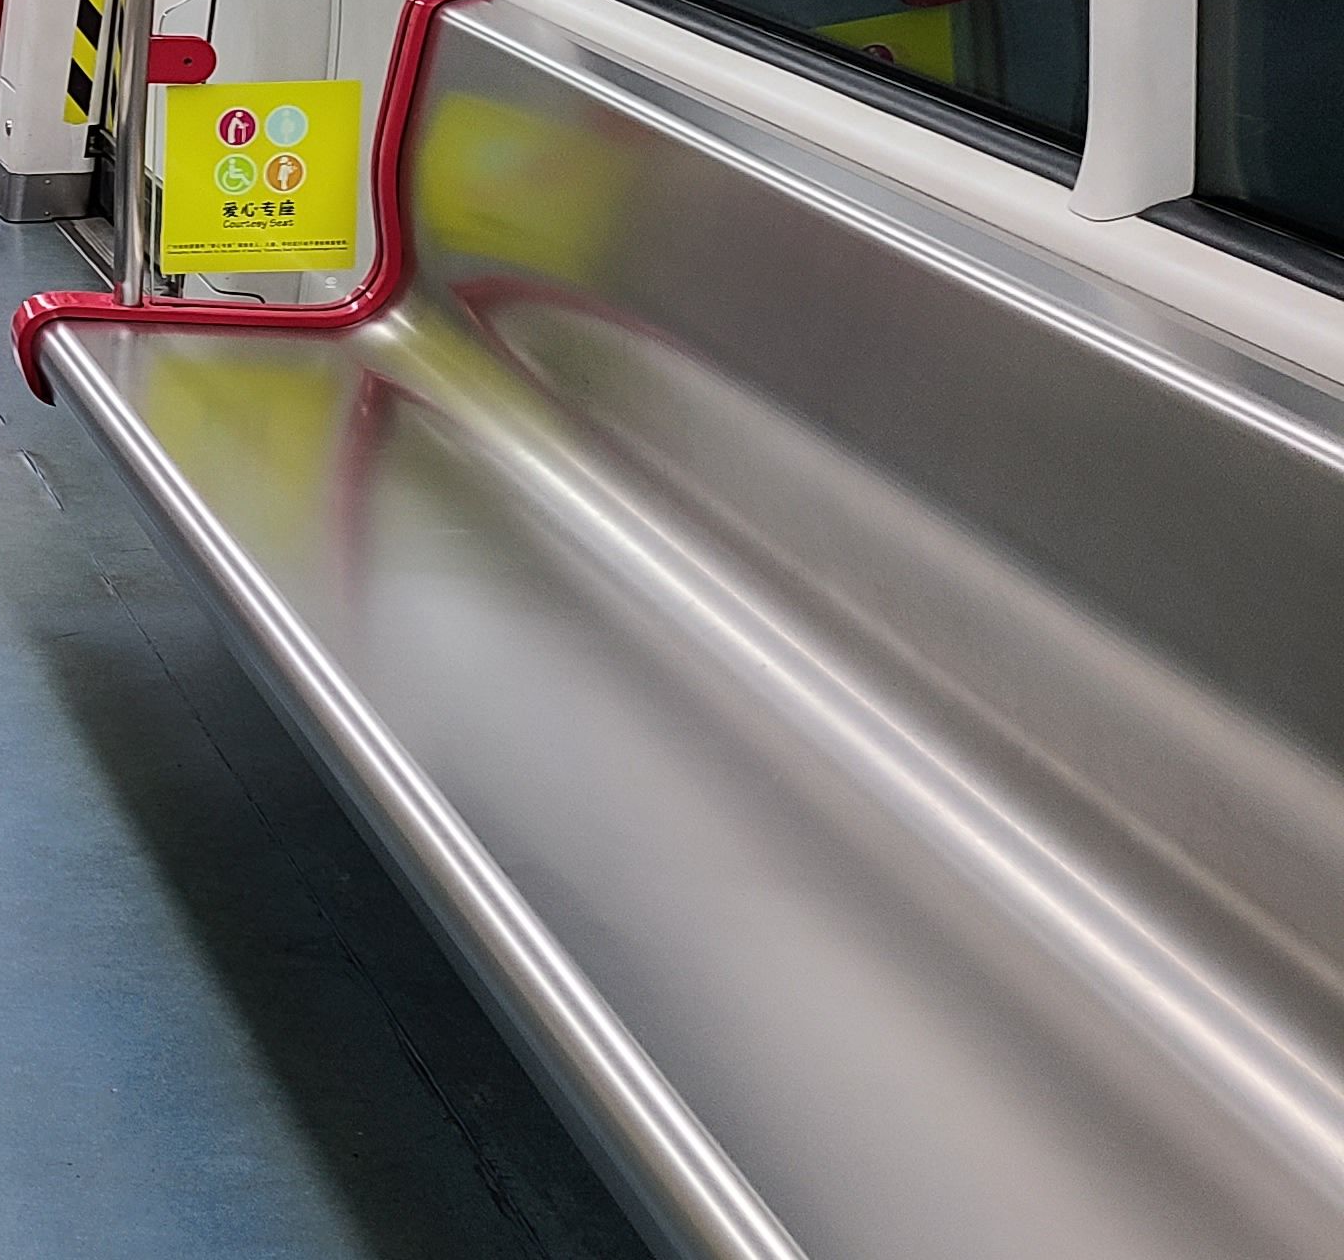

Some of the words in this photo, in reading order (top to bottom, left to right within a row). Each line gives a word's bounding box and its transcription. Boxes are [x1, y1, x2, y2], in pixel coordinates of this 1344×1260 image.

[223, 199, 296, 218] 爱心专座
[223, 220, 267, 230] Courtesy
[269, 218, 294, 228] Seat
